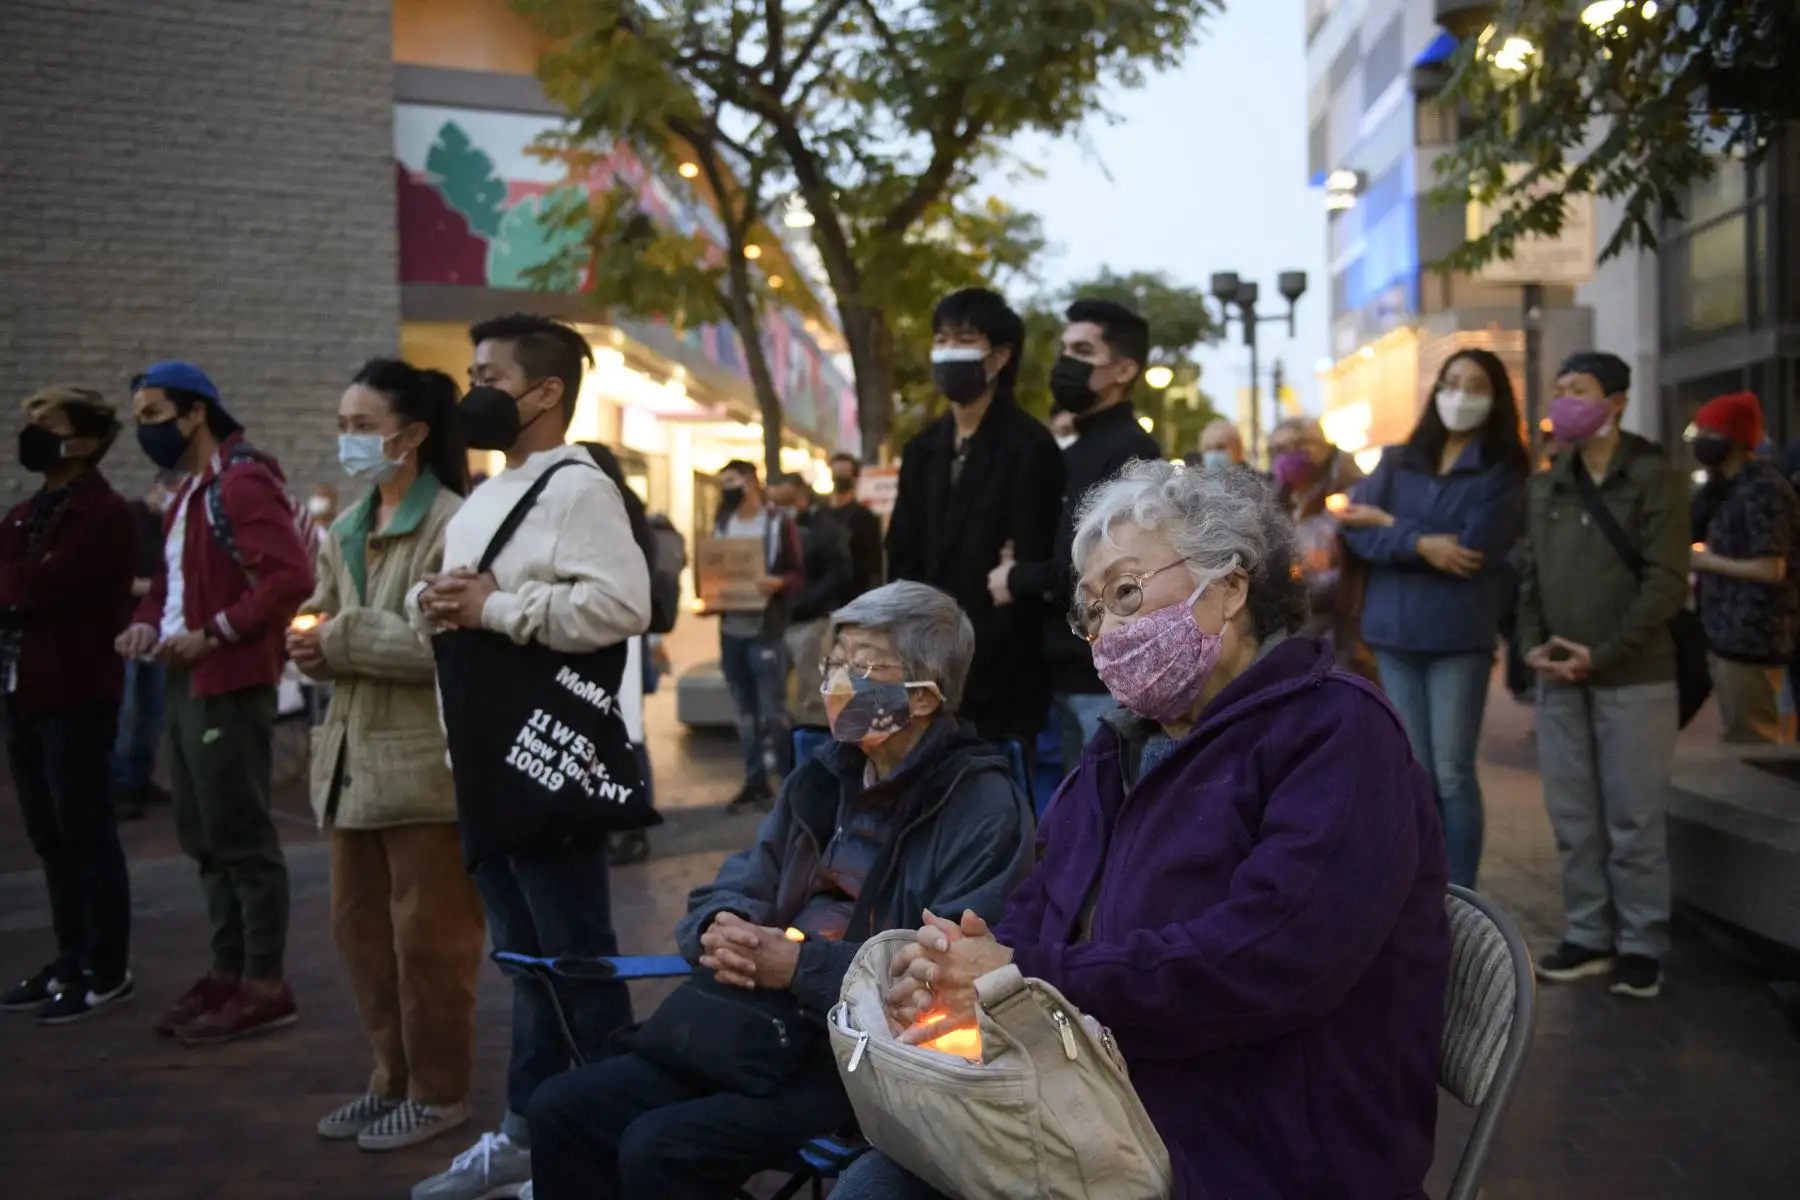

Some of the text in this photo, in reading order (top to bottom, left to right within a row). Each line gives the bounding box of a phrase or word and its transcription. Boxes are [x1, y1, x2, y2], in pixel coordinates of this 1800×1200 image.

[528, 709, 552, 733] 11
[551, 720, 575, 746] W
[570, 734, 596, 761] 53
[505, 746, 565, 792] 10019
[516, 726, 633, 804] New York, NY
